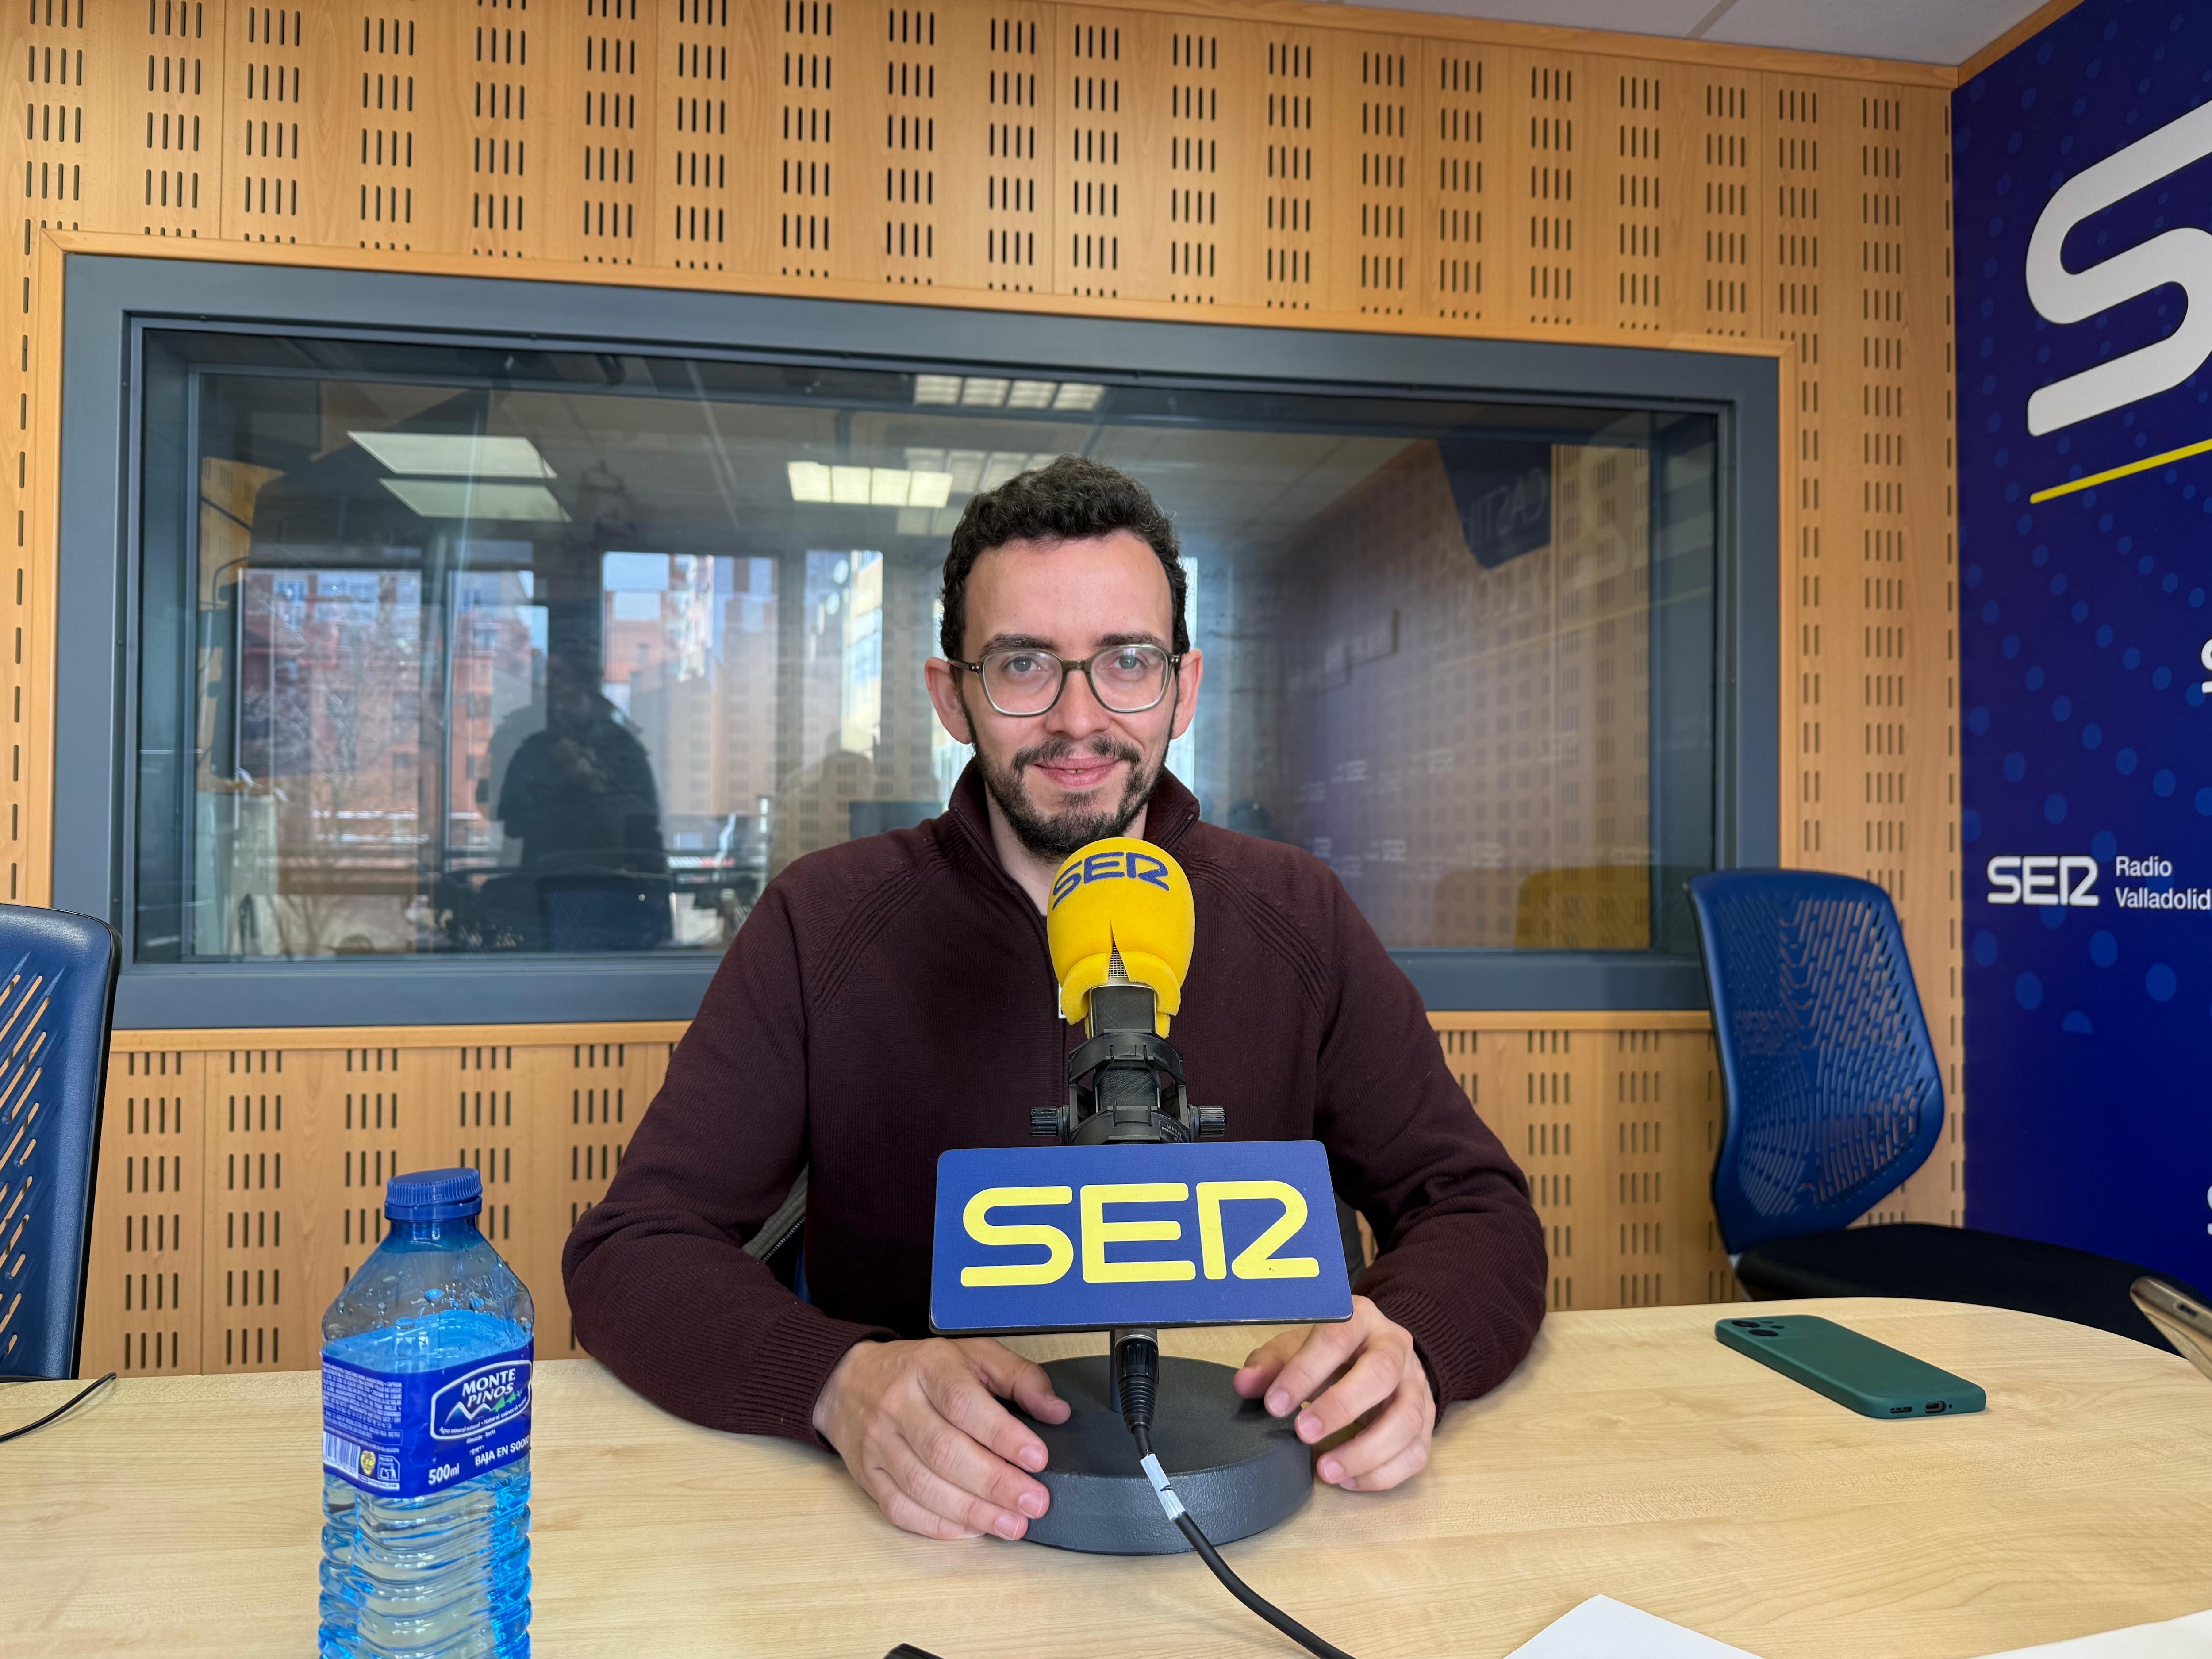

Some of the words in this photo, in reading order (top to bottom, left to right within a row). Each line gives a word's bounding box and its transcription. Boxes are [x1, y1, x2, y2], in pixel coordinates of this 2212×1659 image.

[2115, 855, 2173, 877] Radio
[1052, 850, 1170, 910] SER
[1987, 856, 2100, 906] SER
[2114, 886, 2212, 910] Valladolid
[960, 1180, 1320, 1287] SER
[462, 1368, 515, 1397] MONTE
[466, 1382, 514, 1407] PINOS
[484, 1413, 500, 1425] Natural
[500, 1406, 518, 1418] mineral
[475, 1450, 495, 1467] BAJA
[496, 1444, 509, 1458] EN
